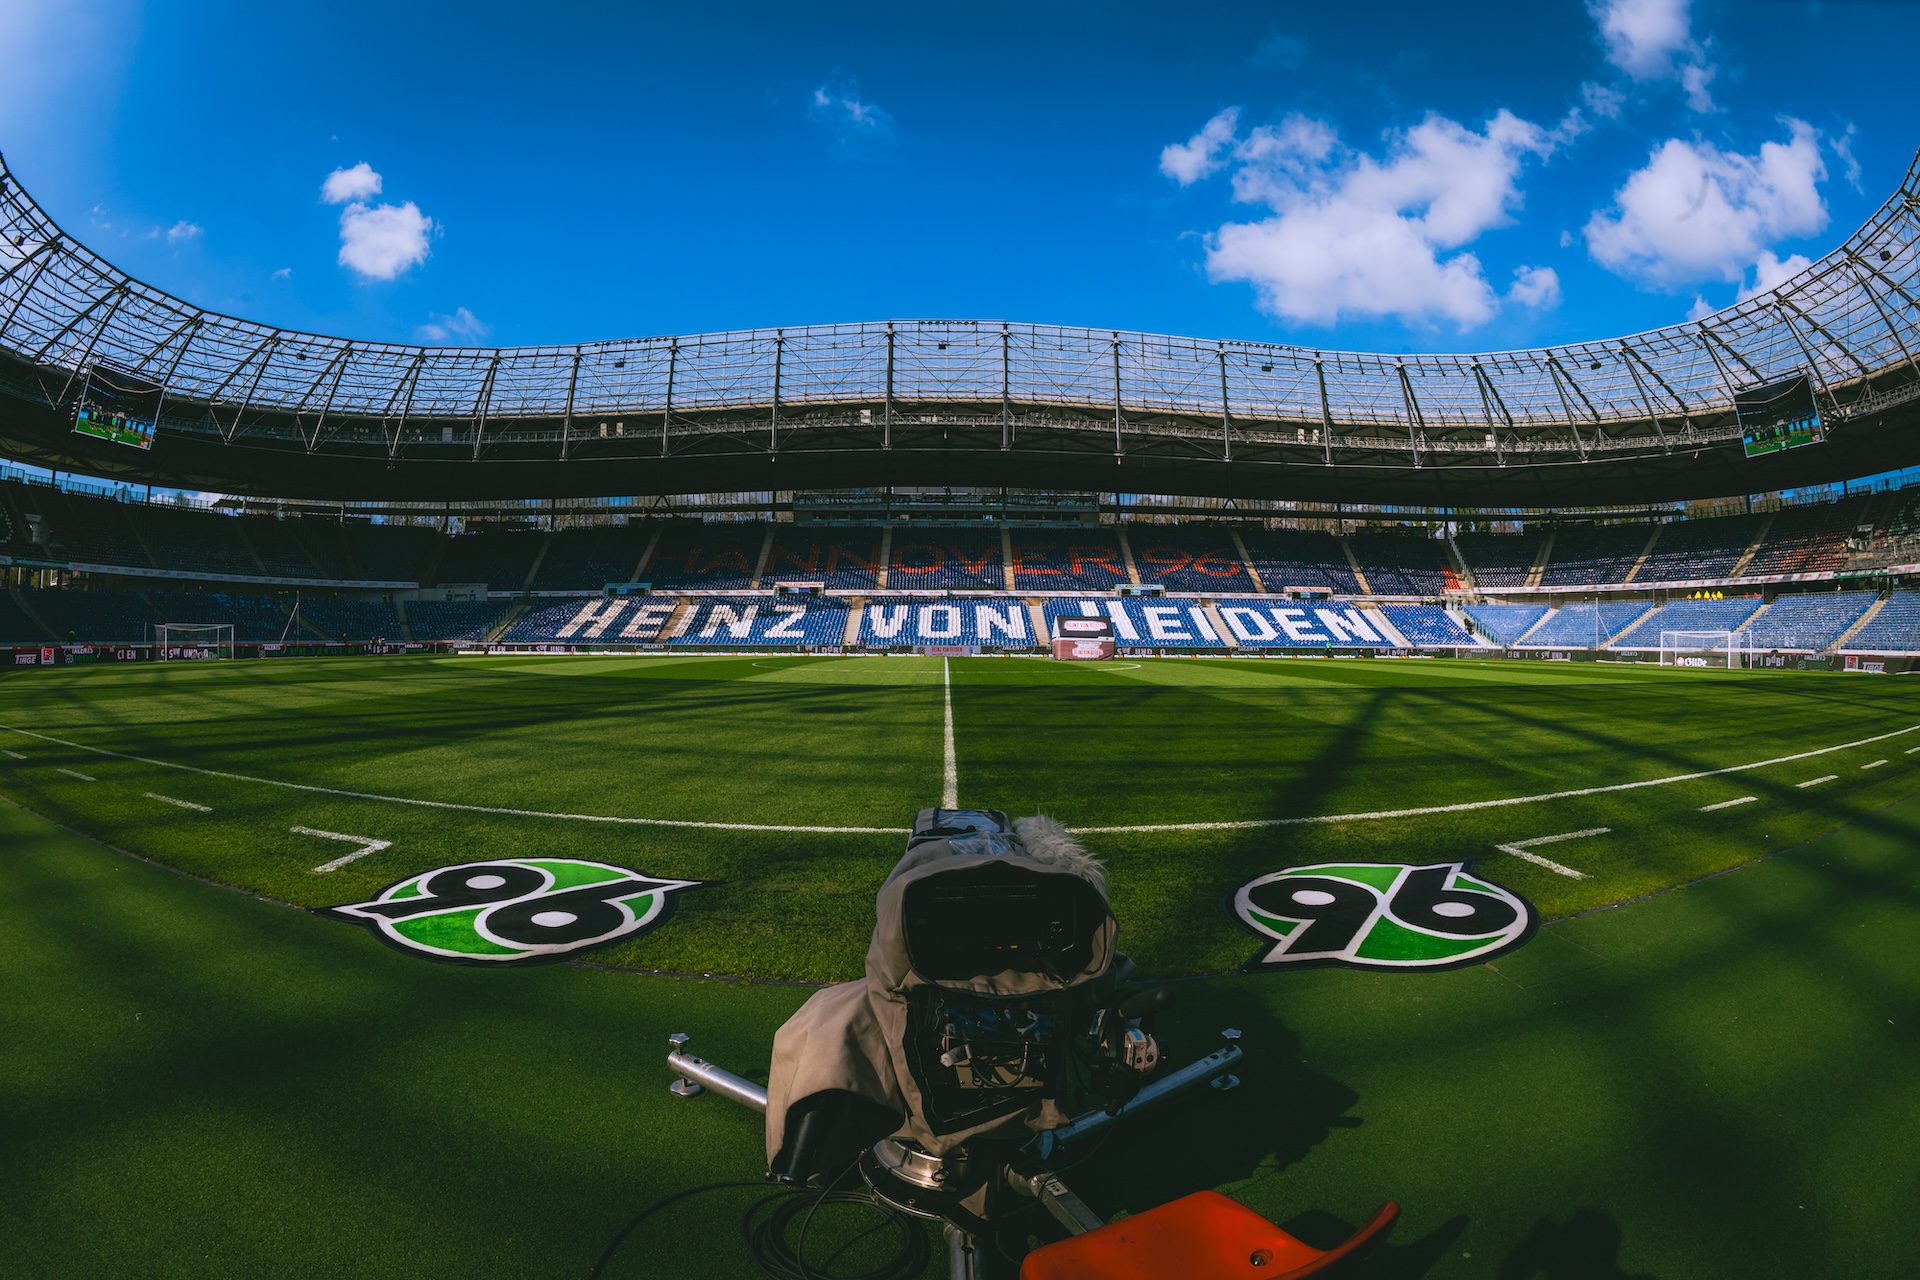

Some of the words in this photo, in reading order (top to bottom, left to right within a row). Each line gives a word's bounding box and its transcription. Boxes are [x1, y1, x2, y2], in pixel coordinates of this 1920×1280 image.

[641, 544, 1125, 575] HANNOVER
[1141, 547, 1241, 577] 96
[556, 599, 807, 640] HEINZ
[868, 604, 1027, 640] VON
[14, 654, 37, 664] TIRGE
[1248, 866, 1520, 956] 96
